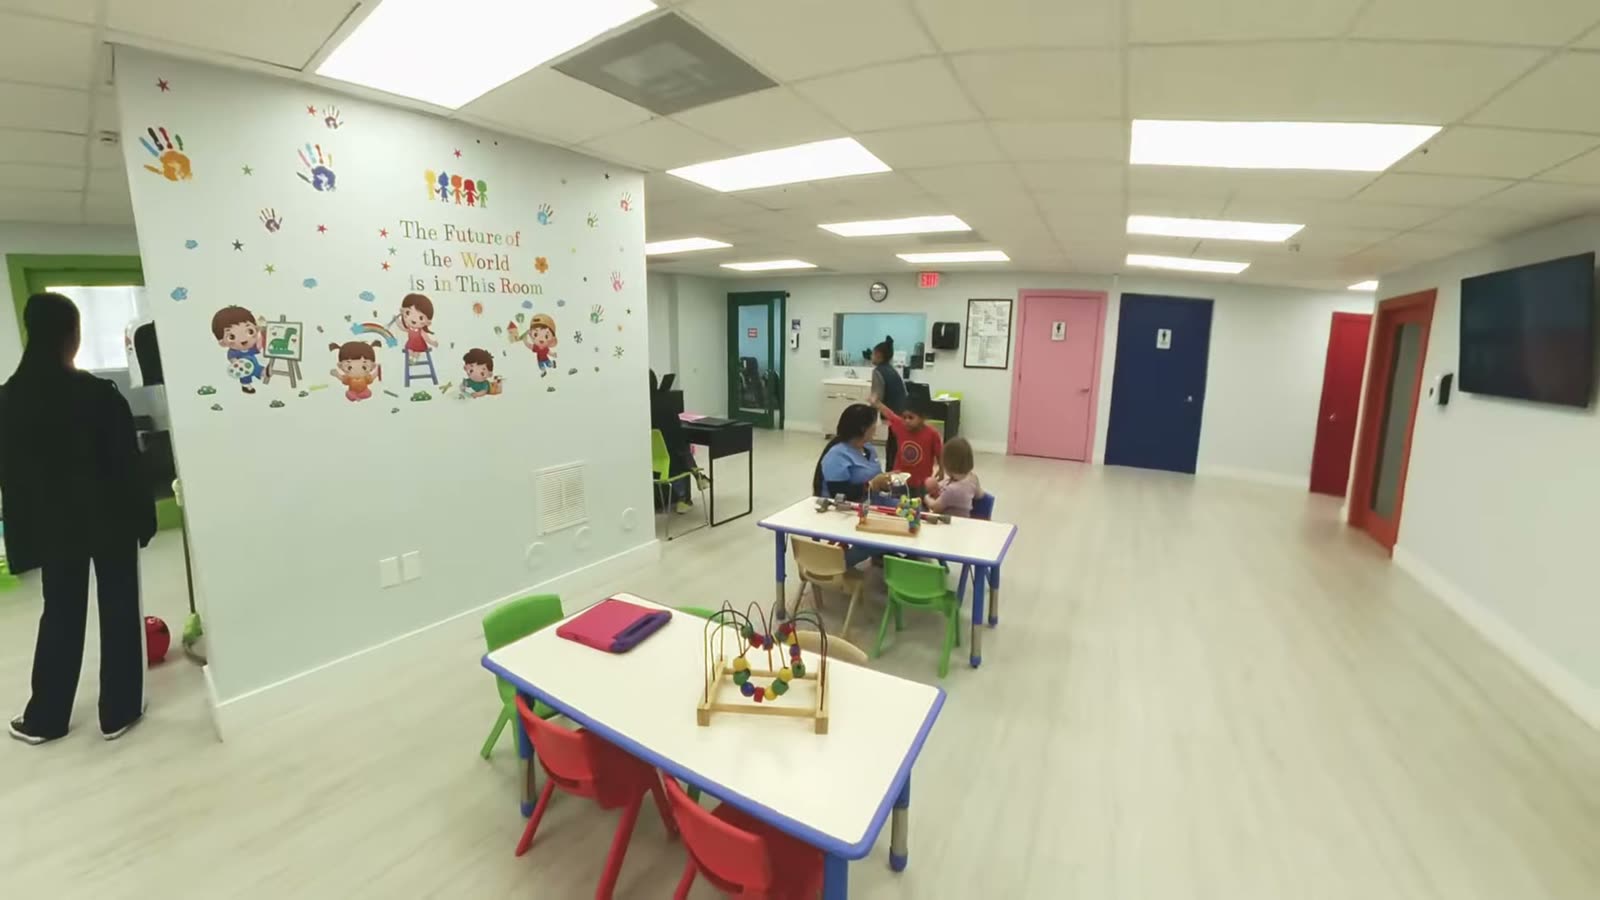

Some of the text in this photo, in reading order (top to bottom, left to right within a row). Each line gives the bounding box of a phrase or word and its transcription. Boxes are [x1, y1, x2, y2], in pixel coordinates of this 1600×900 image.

[400, 220, 521, 247] The Future of
[422, 249, 511, 272] the World
[434, 275, 452, 292] in
[456, 275, 496, 293] This
[500, 277, 543, 295] Room
